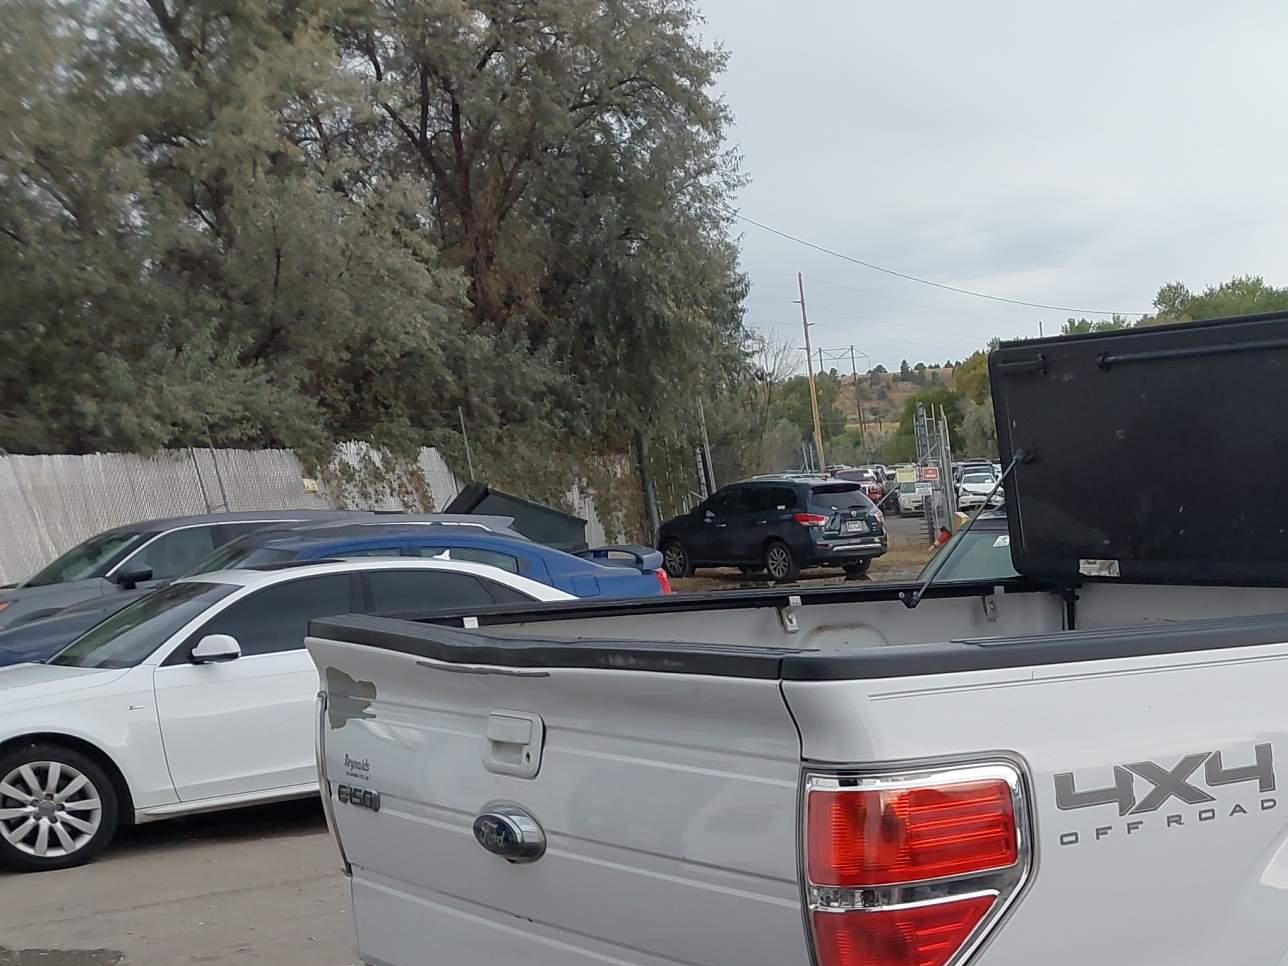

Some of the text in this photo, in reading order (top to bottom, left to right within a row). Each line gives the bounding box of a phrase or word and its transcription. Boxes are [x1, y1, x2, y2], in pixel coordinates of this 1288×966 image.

[1054, 743, 1276, 817] 4X4
[480, 820, 507, 848] Ford
[1059, 798, 1277, 846] OFF ROAD
